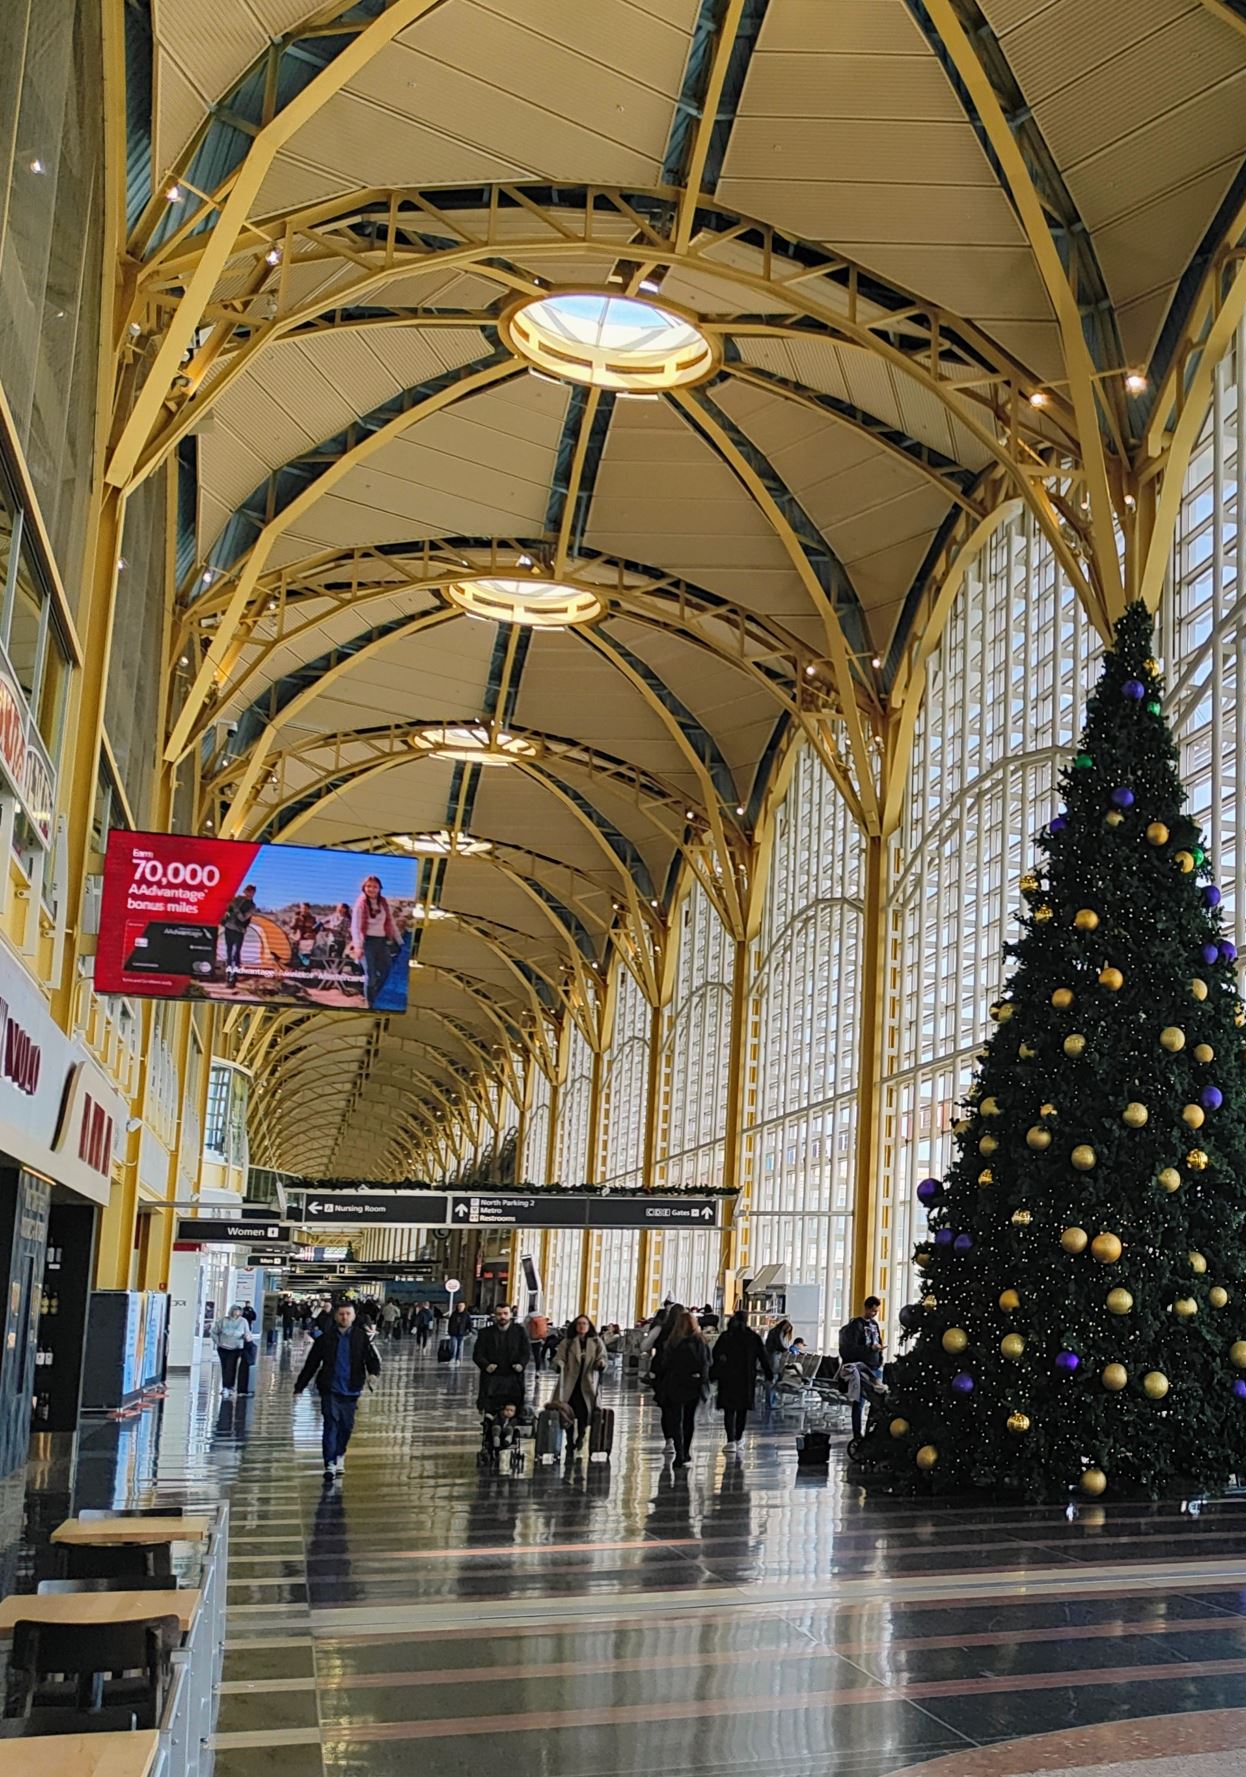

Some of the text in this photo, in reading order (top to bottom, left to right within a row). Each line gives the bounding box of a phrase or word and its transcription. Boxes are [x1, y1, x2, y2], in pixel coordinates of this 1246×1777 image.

[132, 848, 154, 859] Earn
[132, 858, 221, 887] 70,000
[127, 897, 199, 914] bonus miles
[5, 1017, 42, 1096] VOLO
[502, 1199, 530, 1208] Parking
[529, 1199, 536, 1207] 2
[334, 1204, 387, 1214] Nursing Room
[479, 1214, 516, 1222] Restrooms
[227, 1227, 265, 1236] Women
